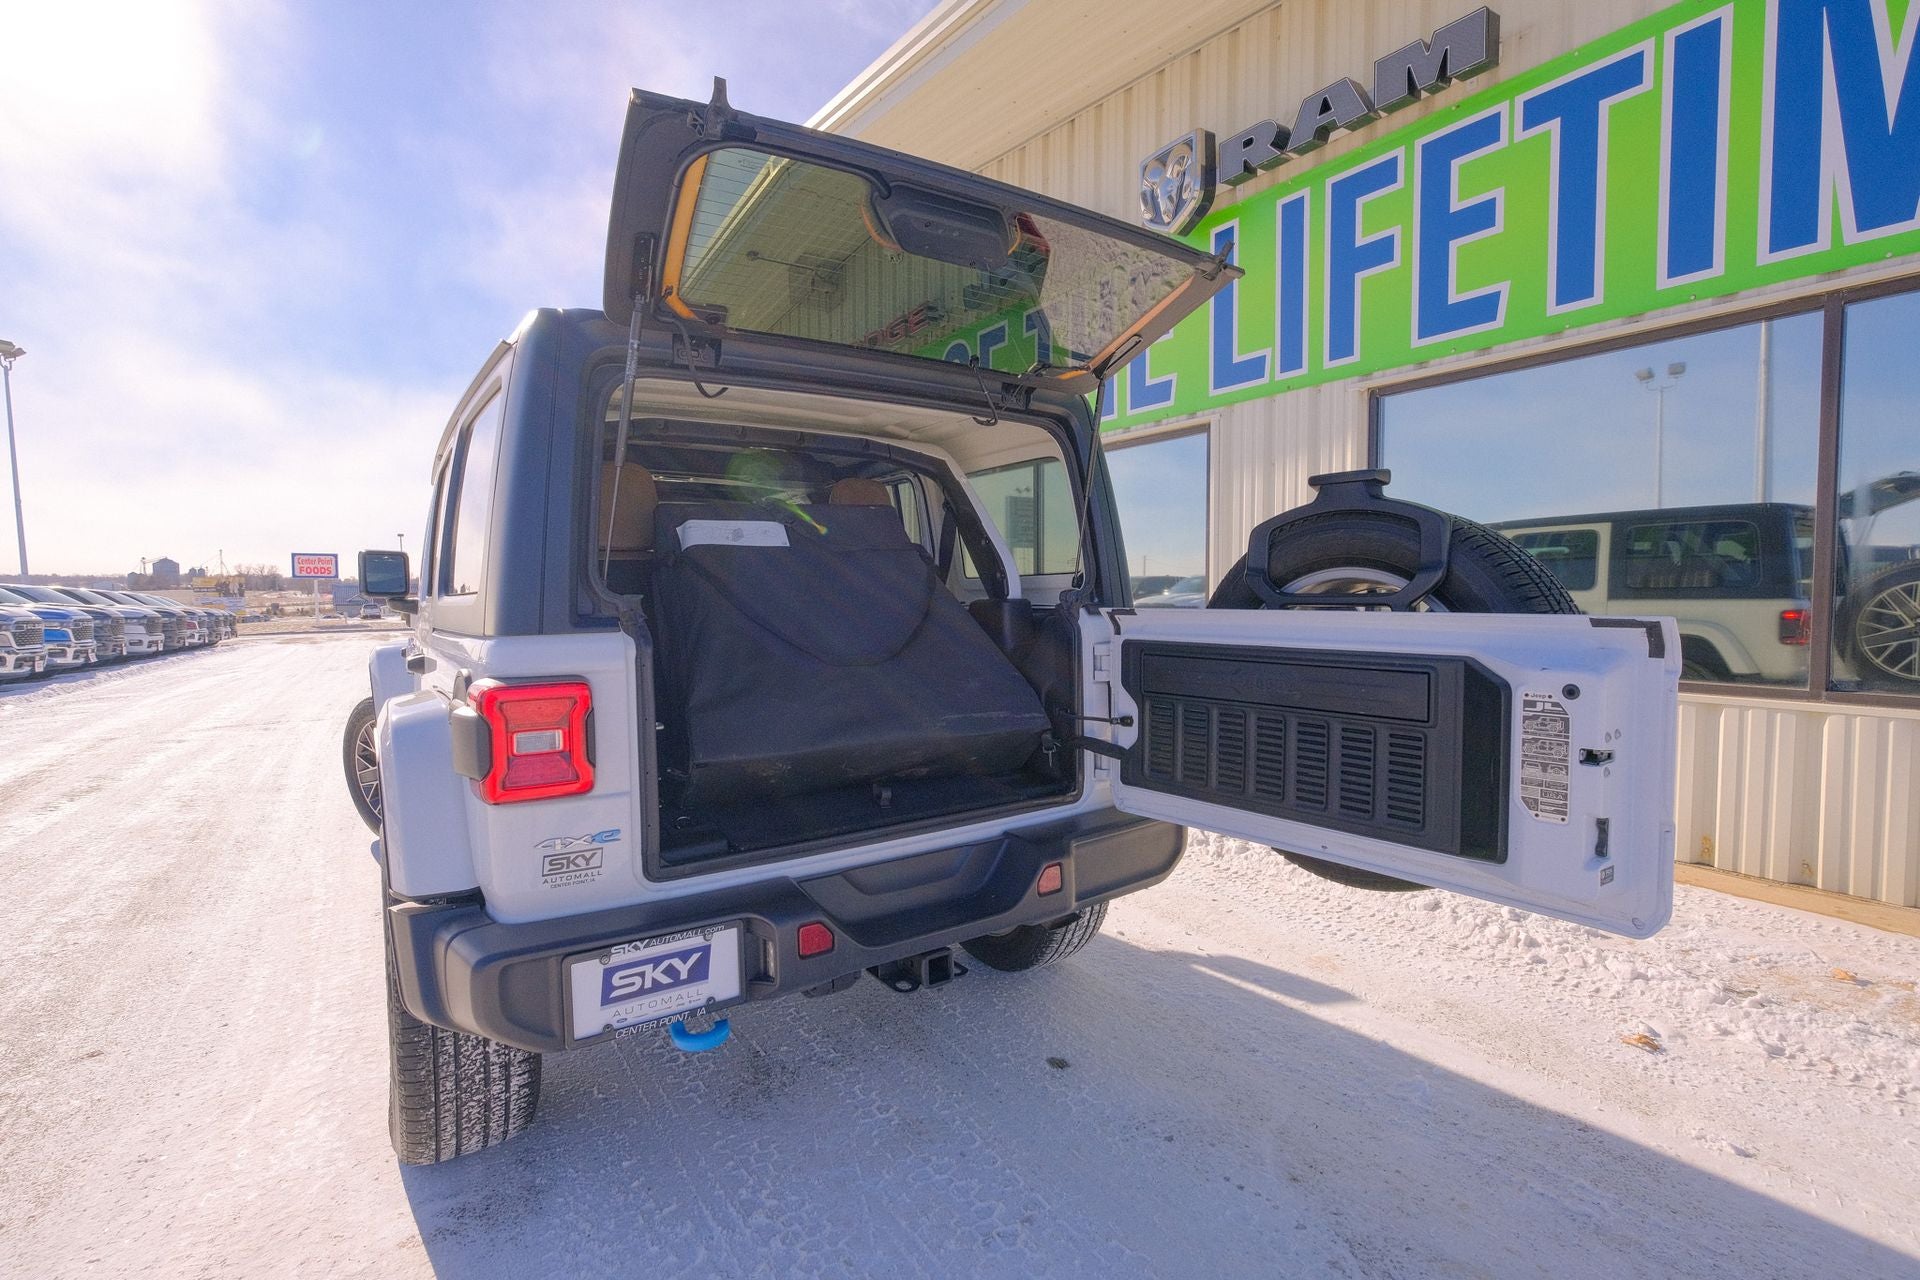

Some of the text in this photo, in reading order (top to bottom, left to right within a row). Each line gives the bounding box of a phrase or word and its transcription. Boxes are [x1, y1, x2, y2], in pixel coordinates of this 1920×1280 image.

[1219, 6, 1500, 187] RAM
[297, 557, 333, 565] Center Point
[299, 566, 332, 575] FOODS
[547, 851, 598, 872] SKY
[542, 870, 603, 884] AUTOMALL
[550, 881, 572, 889] CENTER
[608, 951, 703, 999] SKY
[612, 988, 704, 1018] AUTOMALL
[615, 1020, 658, 1039] CENTER
[660, 1011, 692, 1026] POINT,
[696, 1006, 707, 1016] IA
